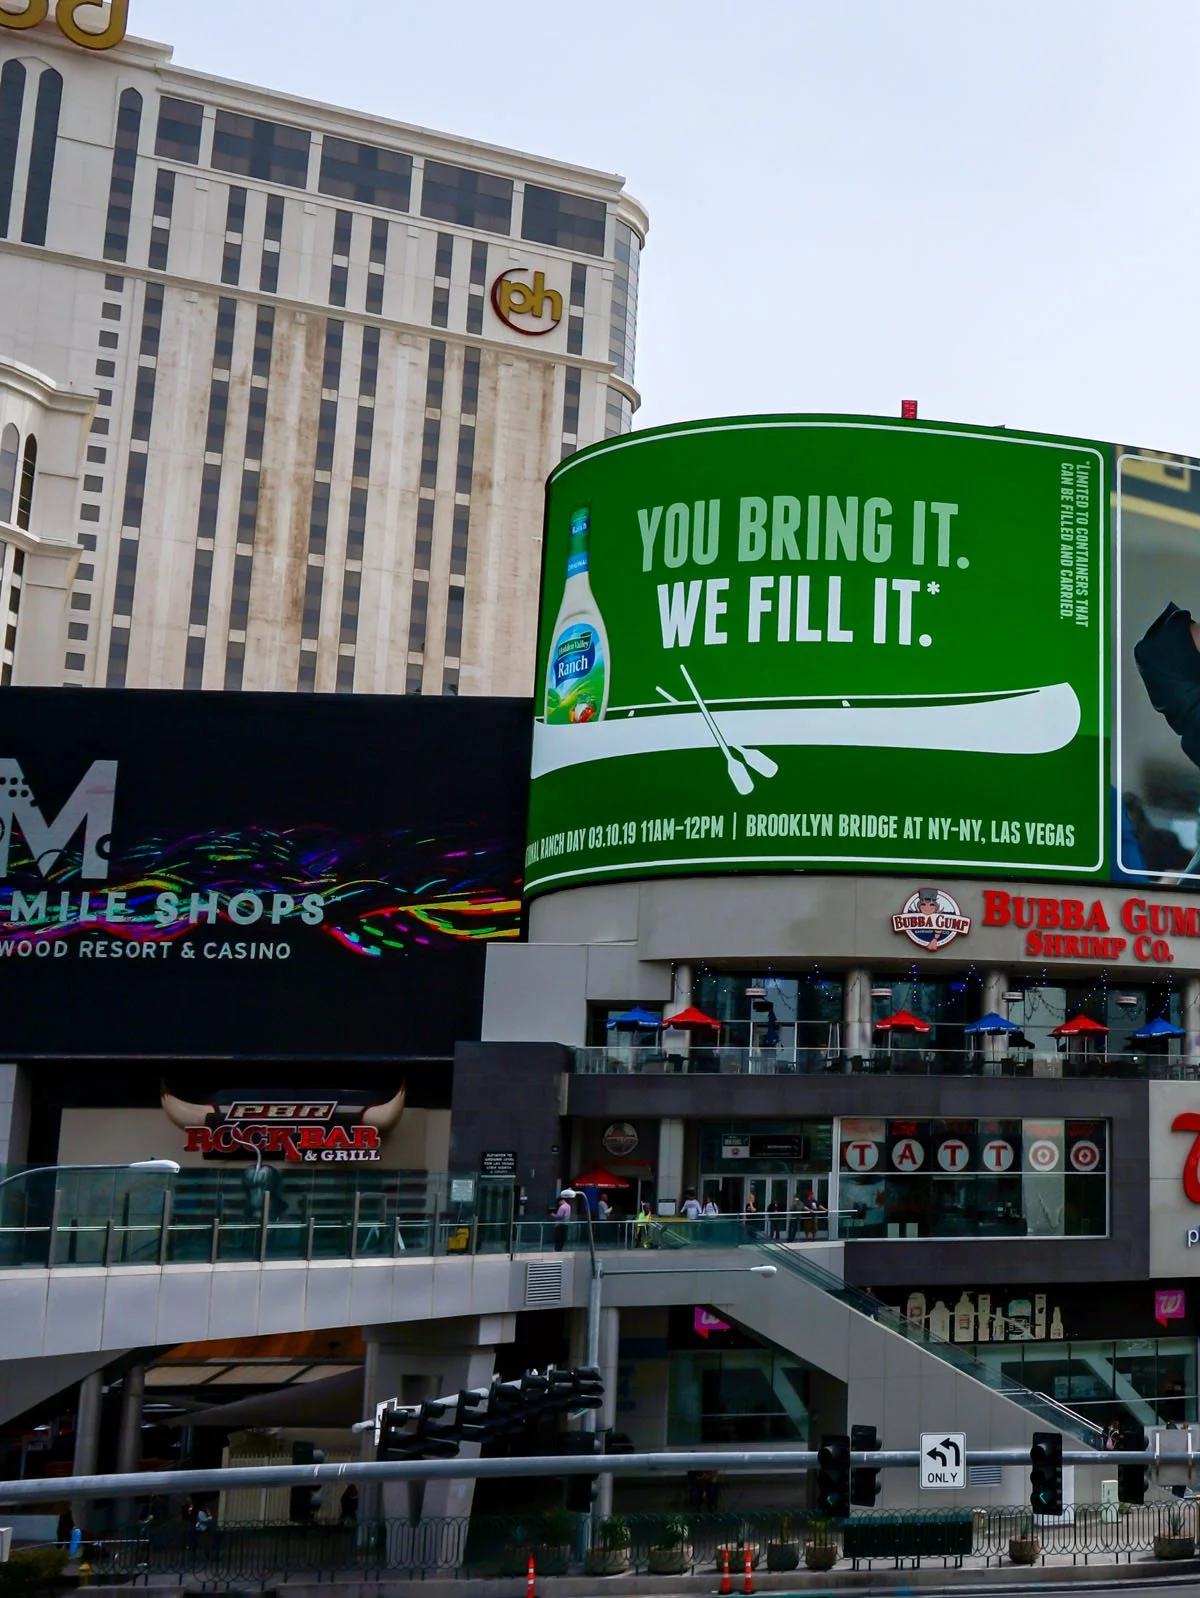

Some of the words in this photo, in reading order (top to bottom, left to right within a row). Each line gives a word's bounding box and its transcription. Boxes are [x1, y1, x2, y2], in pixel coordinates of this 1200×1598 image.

[1061, 462, 1074, 485] CAN
[1061, 487, 1074, 502] BE
[1061, 504, 1074, 541] FILLED
[1076, 511, 1088, 525] TO
[636, 498, 721, 573] YOU
[738, 495, 893, 565] BRING
[911, 500, 970, 570] IT.
[1060, 543, 1074, 567] AND
[1076, 527, 1088, 596] CONTAINERS
[1060, 569, 1074, 620] CARRIED.
[656, 577, 730, 649] WE
[747, 575, 854, 643] FILL
[1076, 599, 1088, 627] THAT
[558, 655, 588, 678] Ranch
[540, 832, 565, 861] RANCH
[567, 828, 587, 853] DAY
[588, 821, 637, 849] 03.10.19
[641, 815, 724, 843] 11AM-12PM
[746, 813, 833, 837] BROOKLYN
[838, 813, 898, 838] BRIDGE
[903, 816, 923, 840] AT
[928, 817, 986, 845] NY-NY,
[991, 820, 1021, 844] LAS
[1025, 822, 1075, 847] VEGAS
[10, 890, 127, 923] MILE
[154, 891, 325, 926] SHOPS
[982, 889, 1111, 933] BUBBA
[894, 915, 934, 929] BUBBA
[935, 914, 969, 931] GUMP
[79, 940, 174, 959] RESORT
[180, 941, 196, 959] &
[203, 942, 291, 960] CASINO
[1024, 929, 1127, 960] SHRIMP
[232, 1104, 331, 1118] PBR
[304, 1149, 318, 1161] &
[320, 1149, 381, 1161] GRILL
[927, 1472, 958, 1483] ONLY
